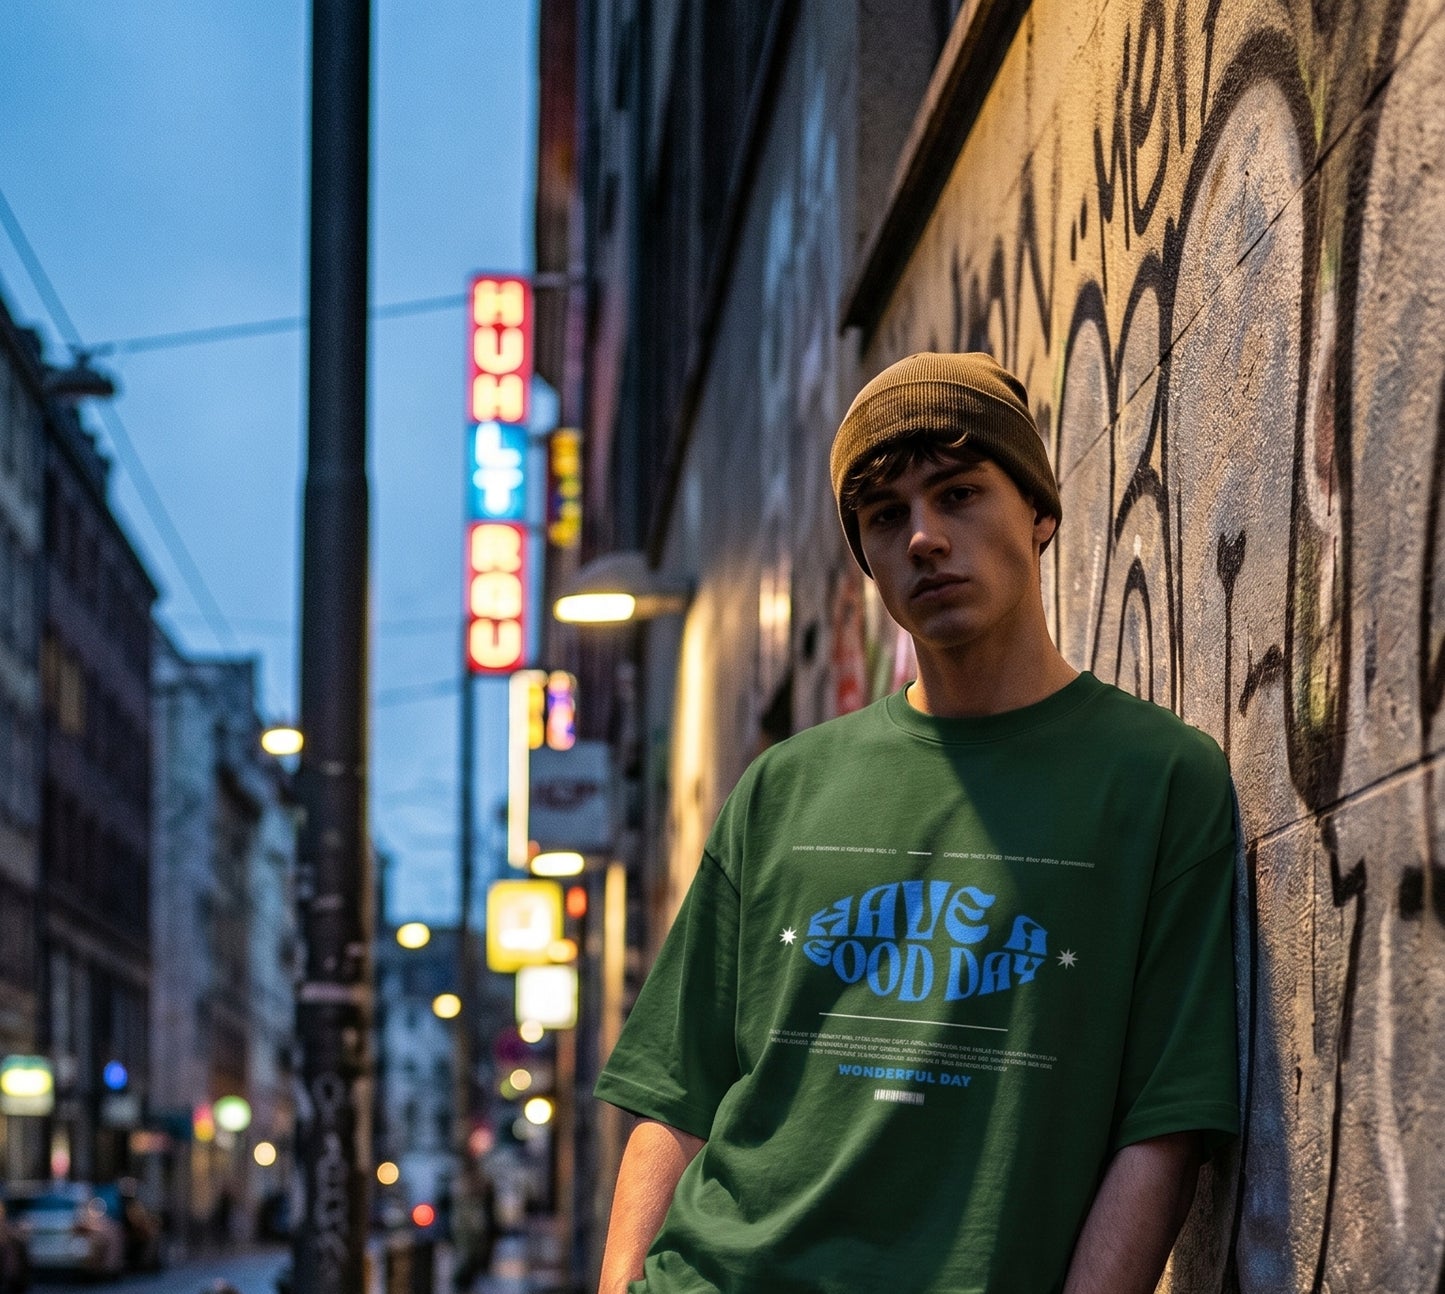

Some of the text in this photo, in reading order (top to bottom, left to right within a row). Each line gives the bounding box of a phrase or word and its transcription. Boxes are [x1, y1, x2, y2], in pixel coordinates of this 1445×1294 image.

[806, 880, 1048, 956] HAVE A
[802, 939, 1046, 1002] GOOD DAY
[838, 1063, 972, 1088] WONDERFUL DAY
